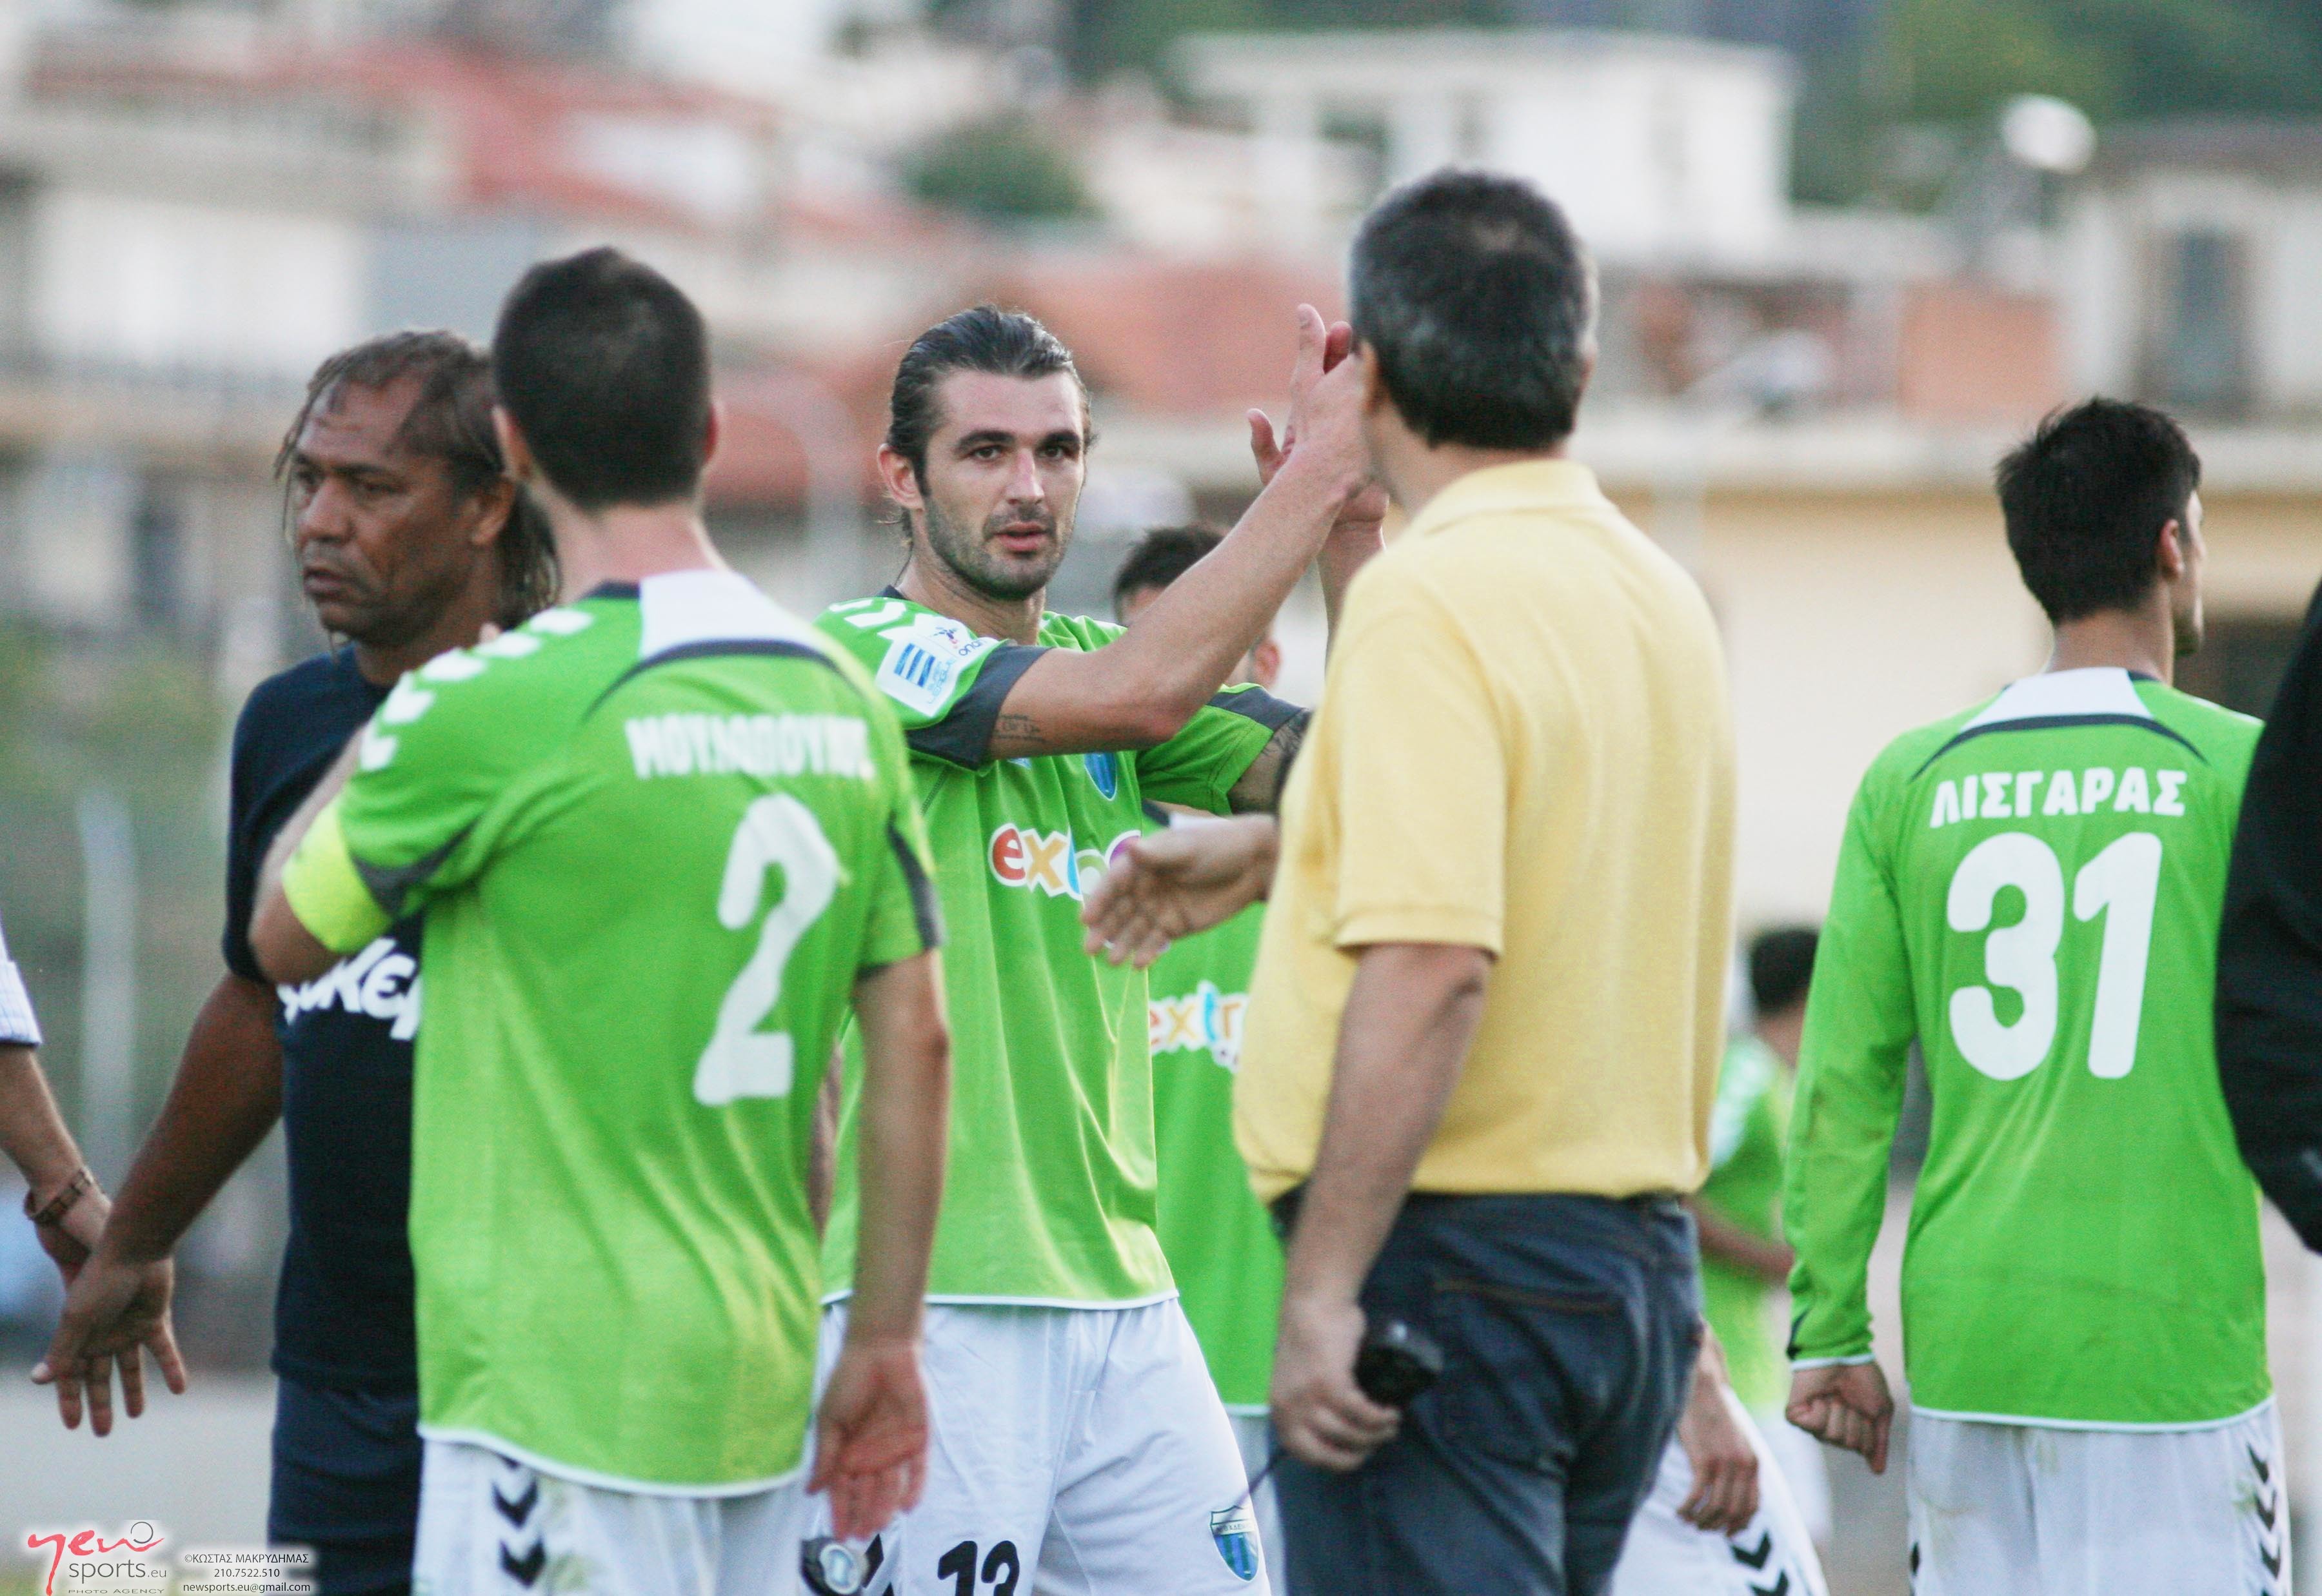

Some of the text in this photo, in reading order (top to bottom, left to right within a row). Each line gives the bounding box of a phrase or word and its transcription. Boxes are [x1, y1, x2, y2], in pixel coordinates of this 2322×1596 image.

[1930, 767, 2188, 829] ΛΙΣΓΑΡΑΣ
[693, 792, 838, 1106] 2
[1947, 832, 2163, 1081] 31
